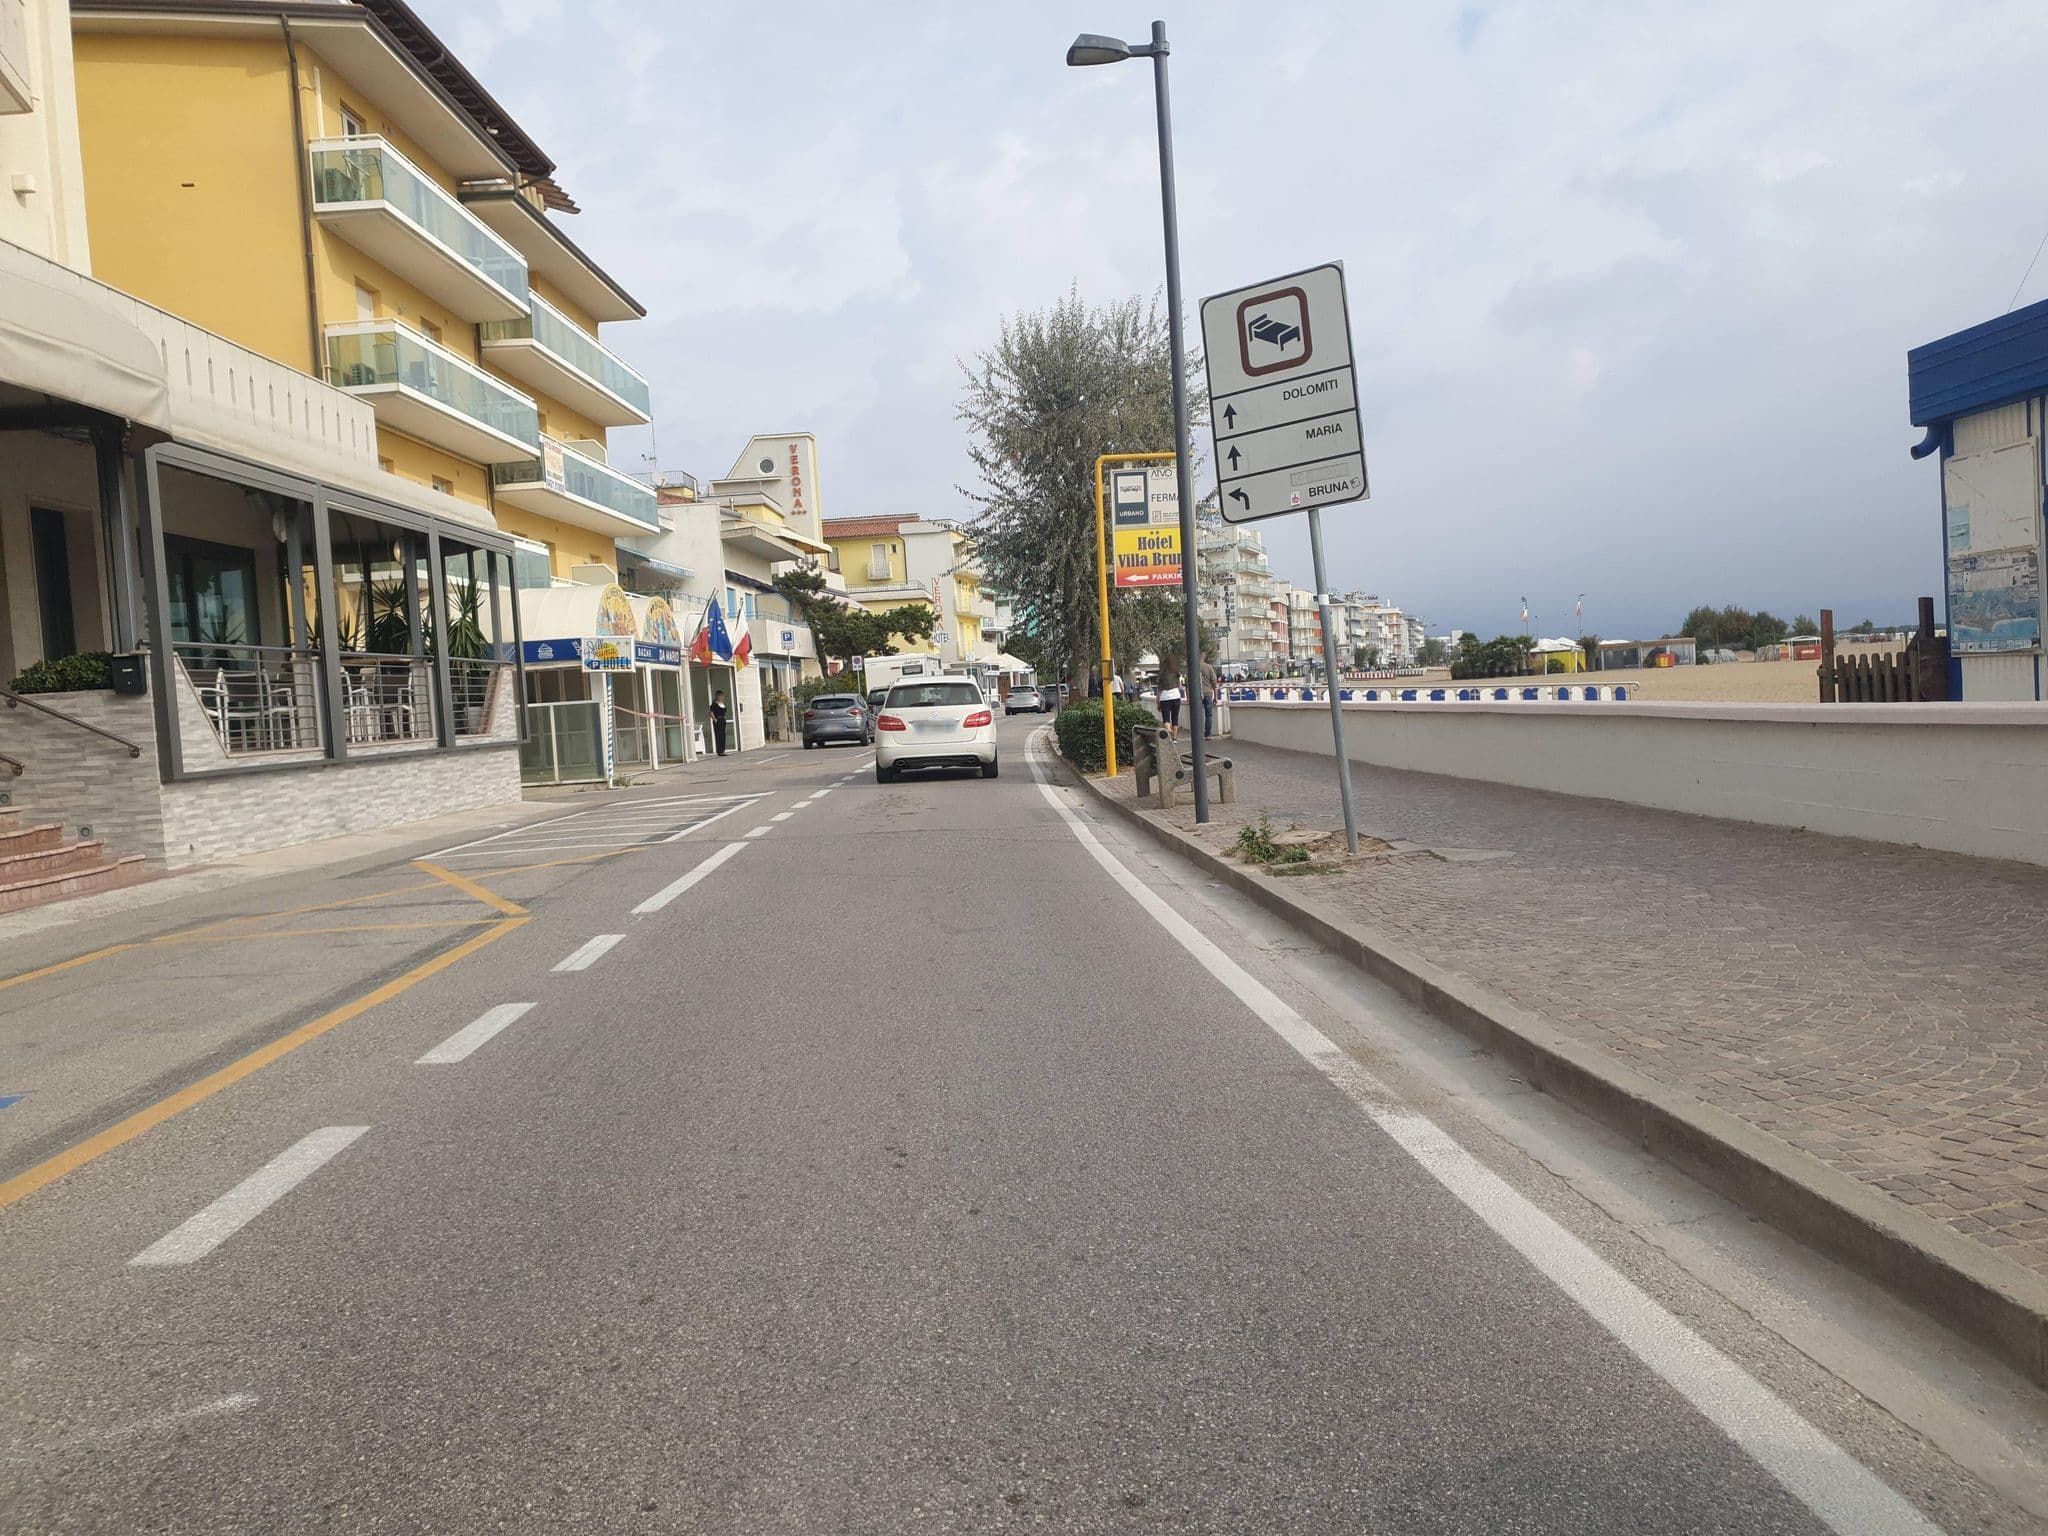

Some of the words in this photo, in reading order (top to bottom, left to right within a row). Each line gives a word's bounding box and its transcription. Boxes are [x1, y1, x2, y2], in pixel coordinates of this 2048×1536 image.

[1283, 379, 1338, 400] DOLOMITI
[1305, 423, 1343, 439] MARIA
[789, 444, 802, 507] VERONA
[1308, 481, 1349, 497] BRUNA
[1151, 493, 1179, 502] FERM
[1137, 535, 1173, 550] Hotel
[1117, 553, 1149, 568] Villa
[933, 577, 944, 630] VEROA
[603, 657, 631, 670] HOTEL
